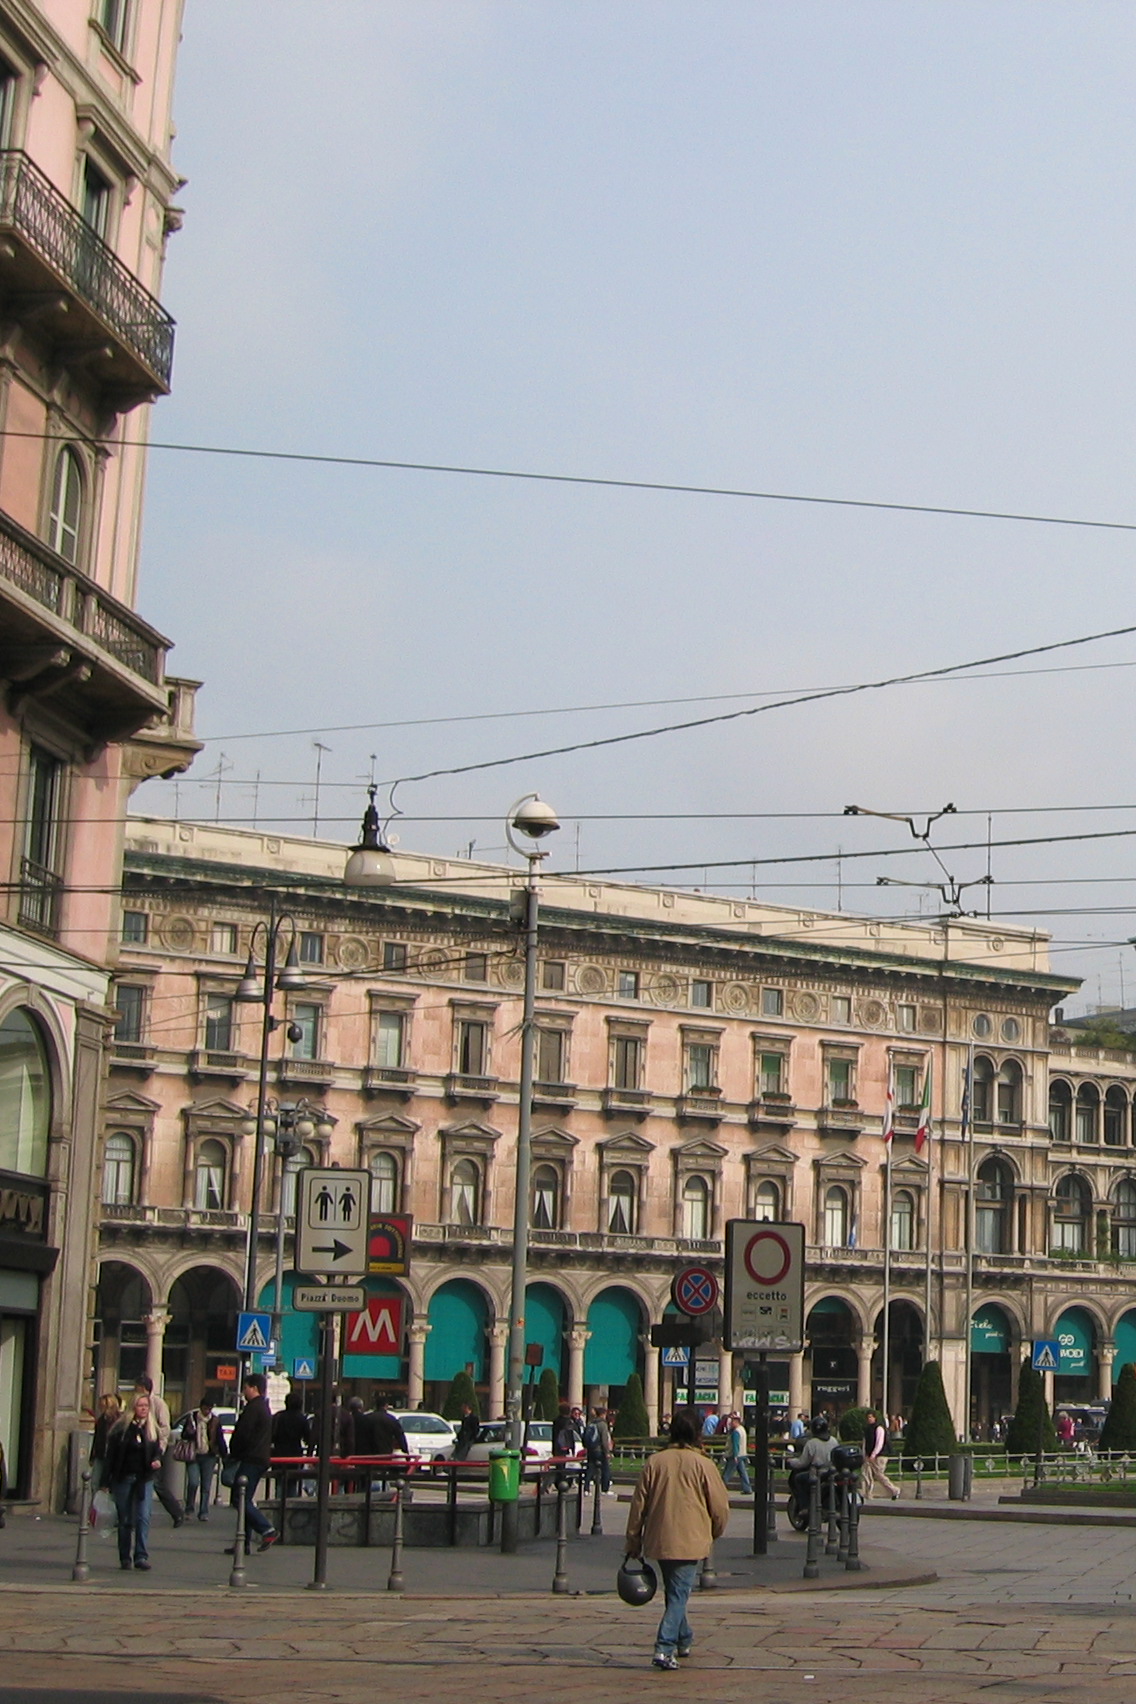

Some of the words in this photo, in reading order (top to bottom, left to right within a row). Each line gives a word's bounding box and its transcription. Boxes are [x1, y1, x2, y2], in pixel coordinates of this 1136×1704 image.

[331, 1293, 360, 1303] Duomo
[746, 1290, 787, 1301] eccetto
[350, 1308, 397, 1343] M
